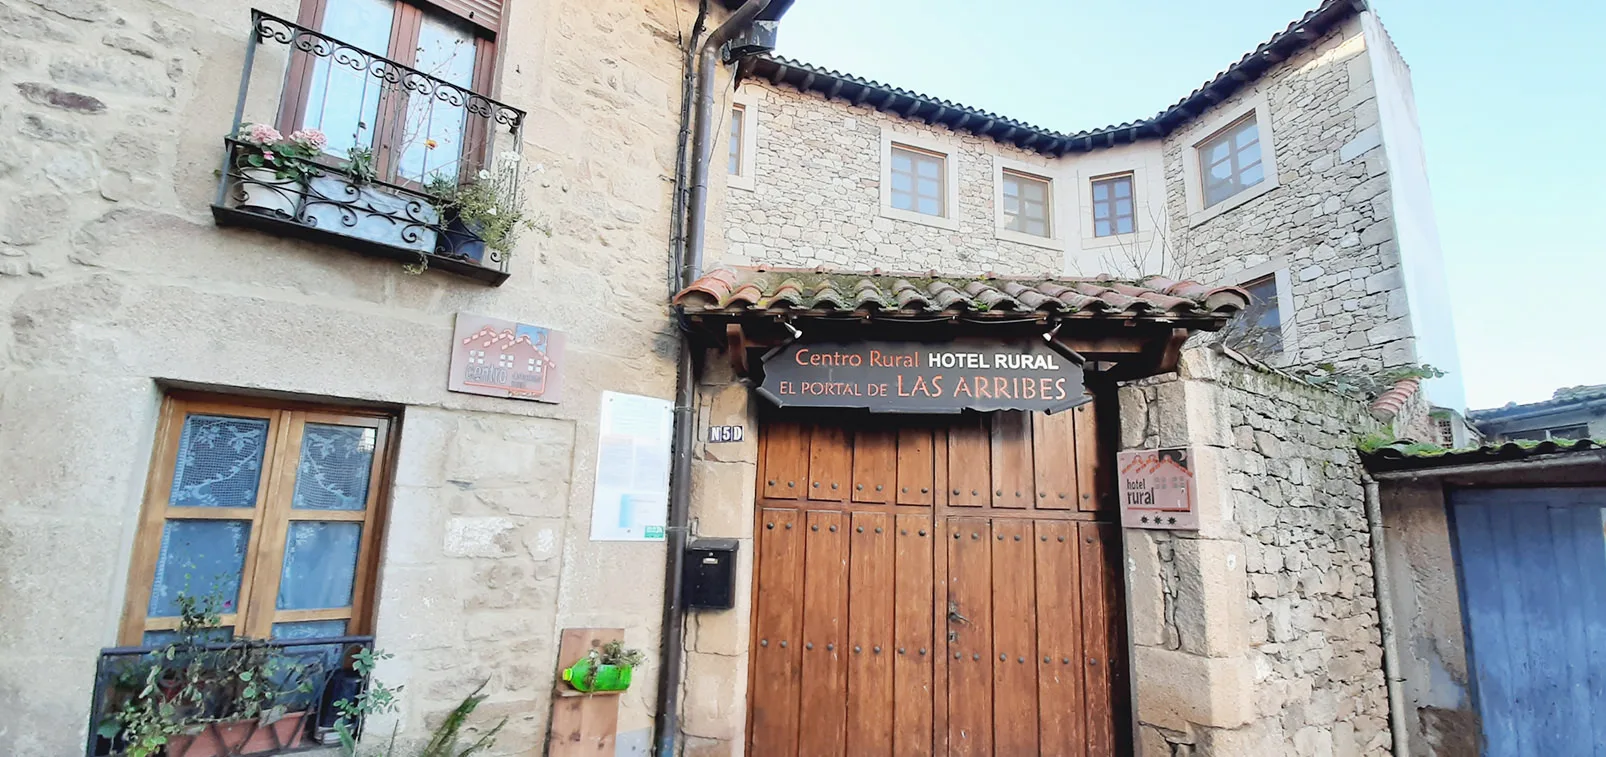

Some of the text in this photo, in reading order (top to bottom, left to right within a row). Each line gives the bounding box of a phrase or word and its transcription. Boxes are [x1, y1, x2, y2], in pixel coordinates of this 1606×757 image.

[795, 349, 1059, 370] Centro Rural HOTEL RURAL
[464, 364, 507, 384] centro
[779, 375, 1066, 400] EL PORTAL DE LAS ARRIBES
[1126, 478, 1146, 490] hotel
[1127, 487, 1155, 505] rural
